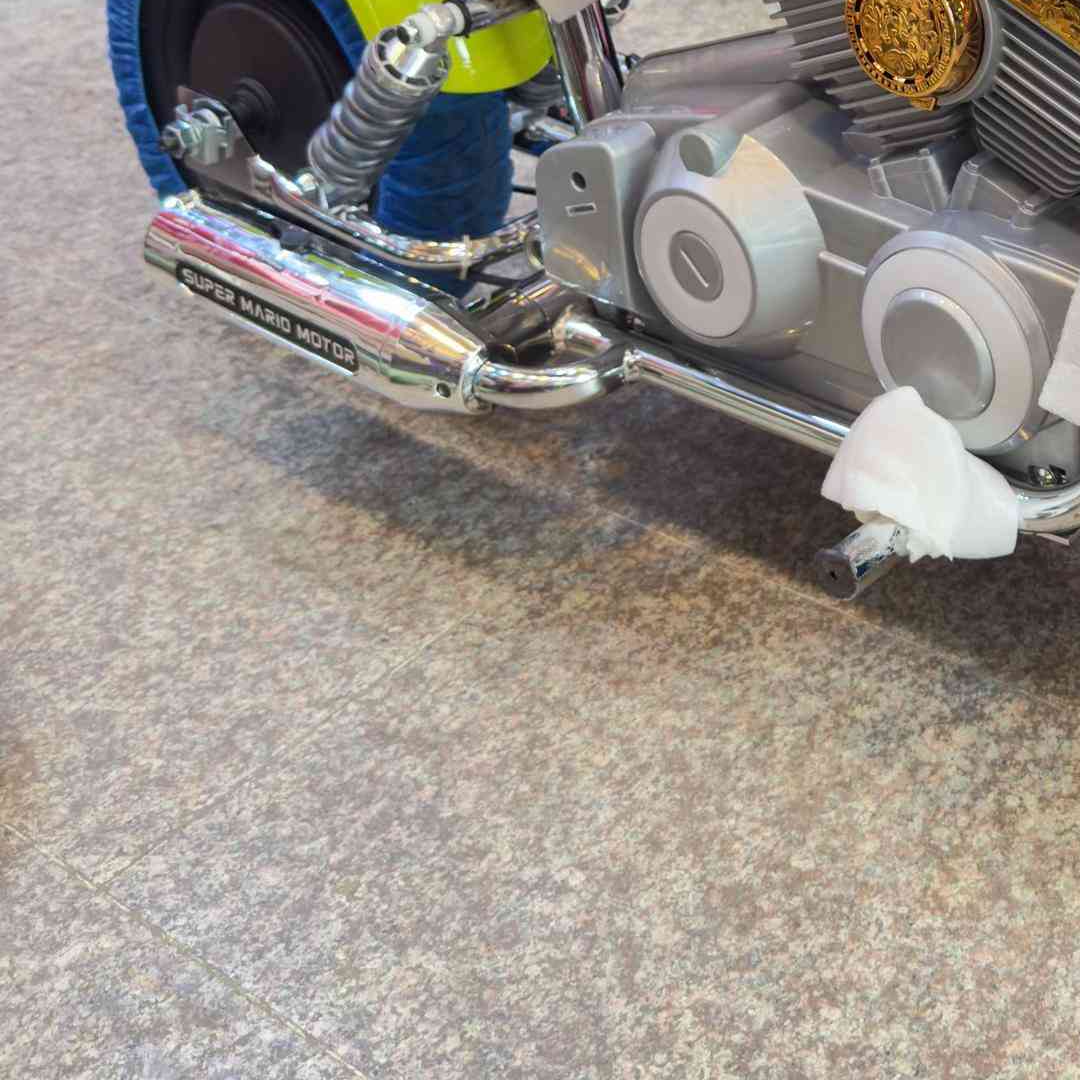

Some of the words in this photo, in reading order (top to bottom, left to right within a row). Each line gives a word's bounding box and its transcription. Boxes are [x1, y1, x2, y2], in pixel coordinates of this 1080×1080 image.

[183, 267, 236, 307] SUPER
[239, 296, 292, 334] MARIO
[295, 321, 356, 366] MOTOR
